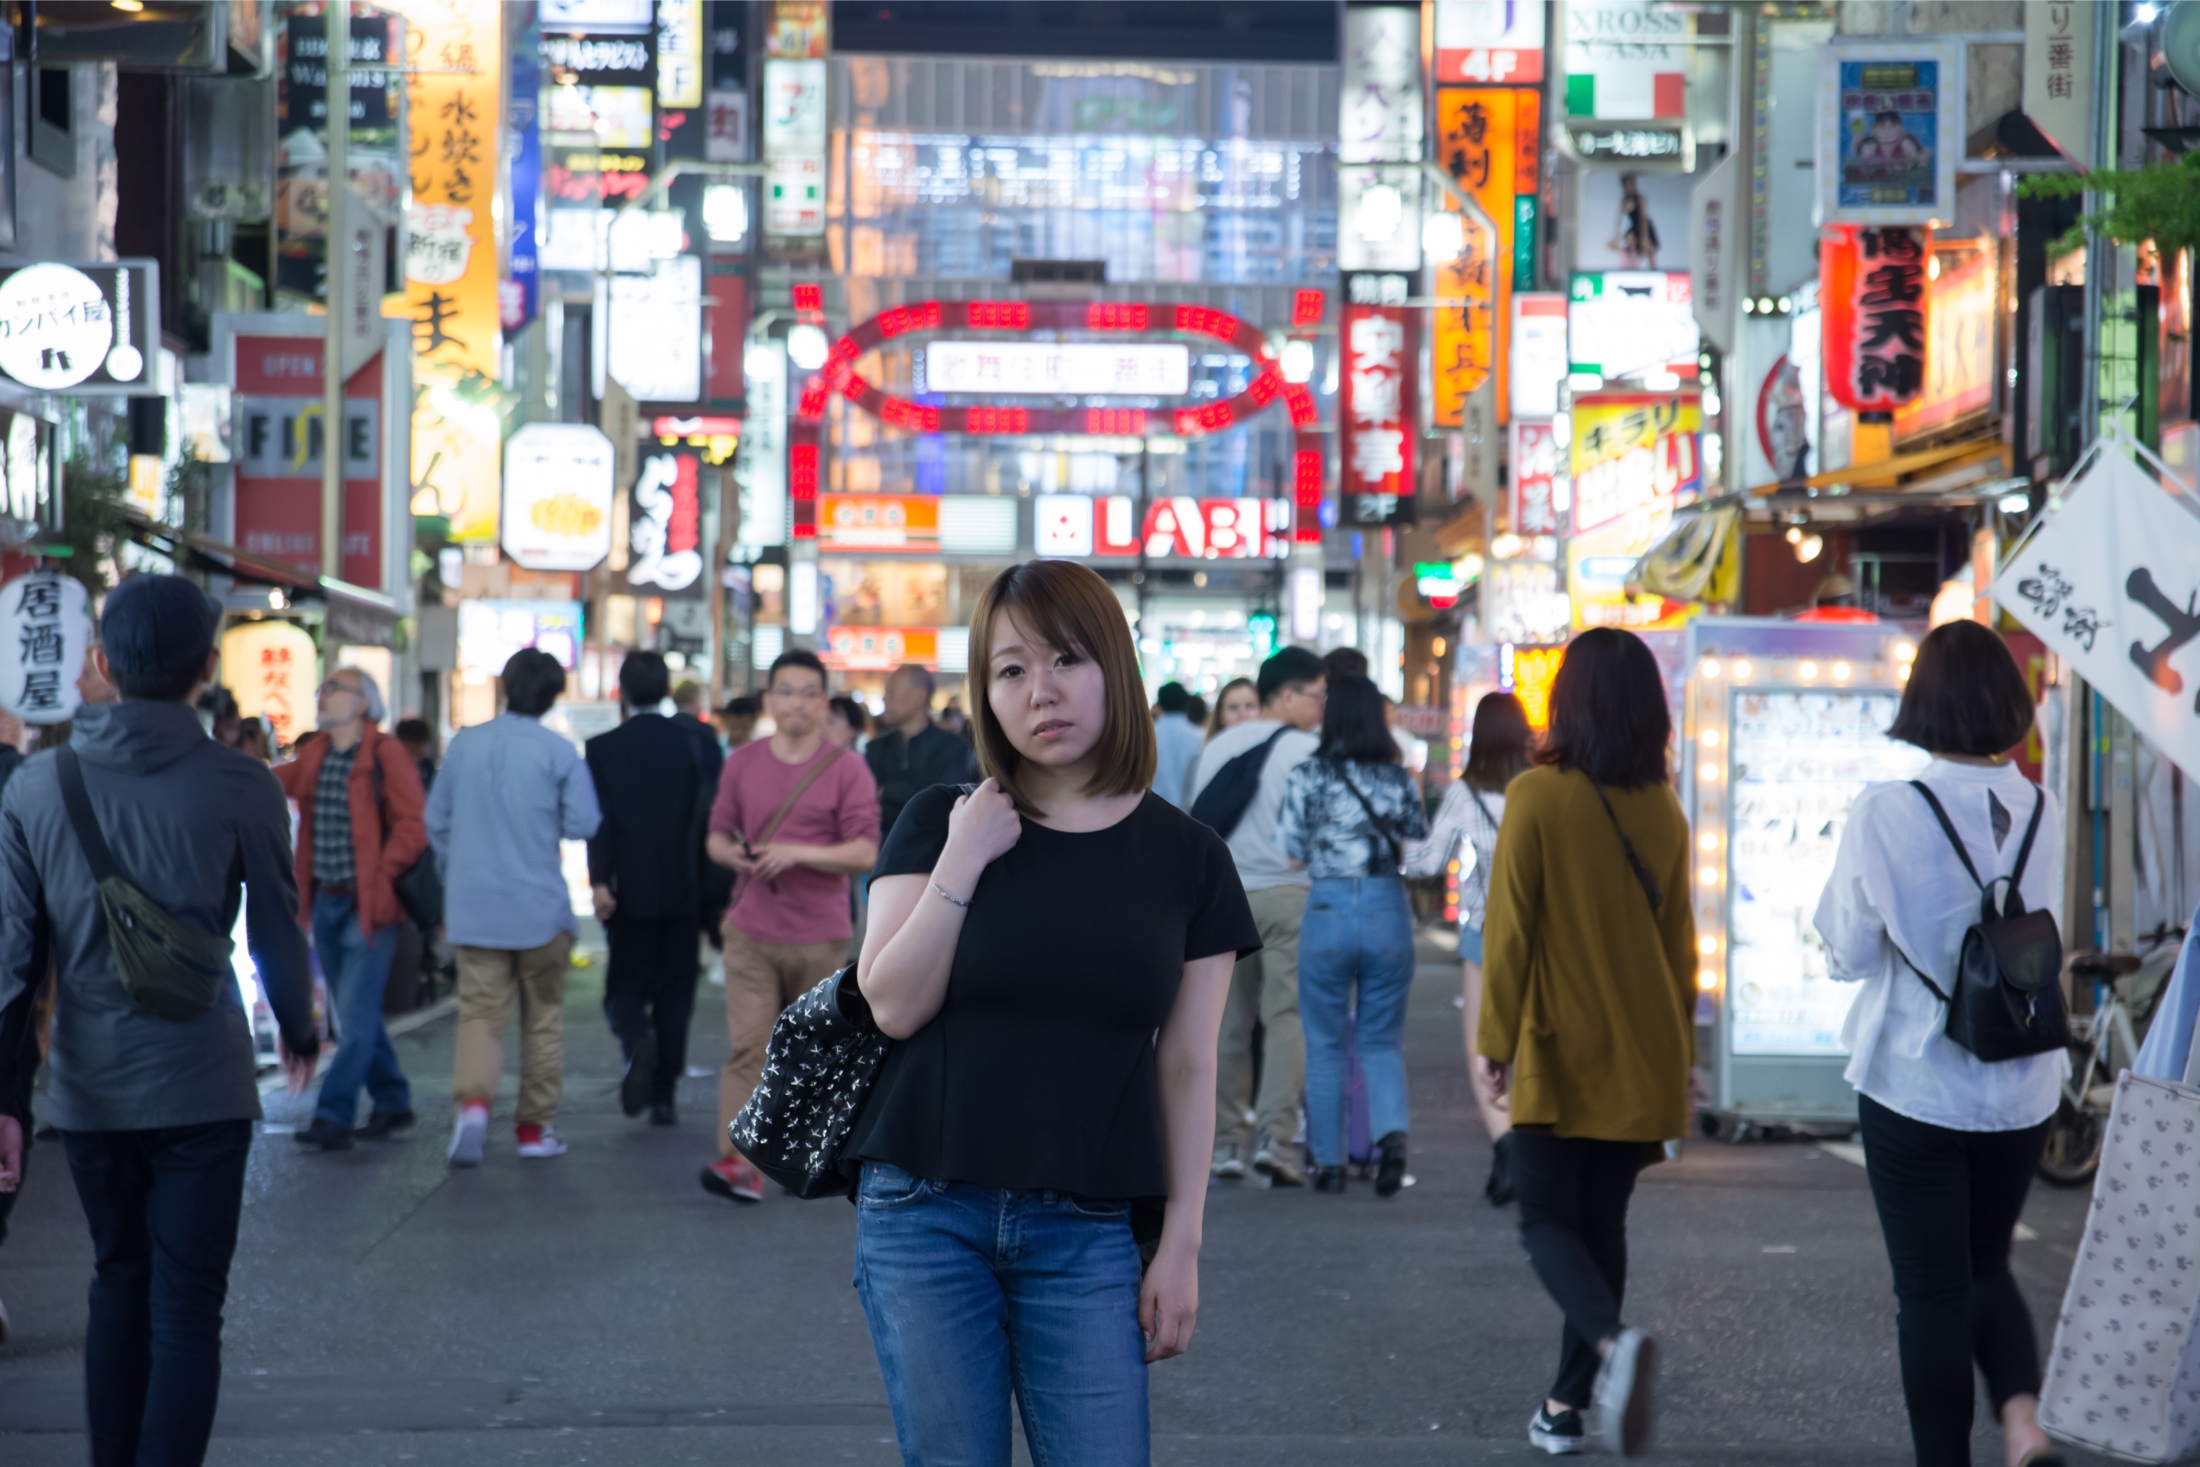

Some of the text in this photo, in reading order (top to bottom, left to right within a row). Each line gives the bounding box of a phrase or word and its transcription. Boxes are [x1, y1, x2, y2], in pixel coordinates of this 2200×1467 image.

[1571, 10, 1684, 35] XROSS
[1460, 49, 1518, 82] 4F
[2047, 0, 2074, 99] り一番街
[263, 354, 315, 377] OPEN
[1583, 398, 1681, 454] キラリ
[16, 579, 64, 711] 居酒屋
